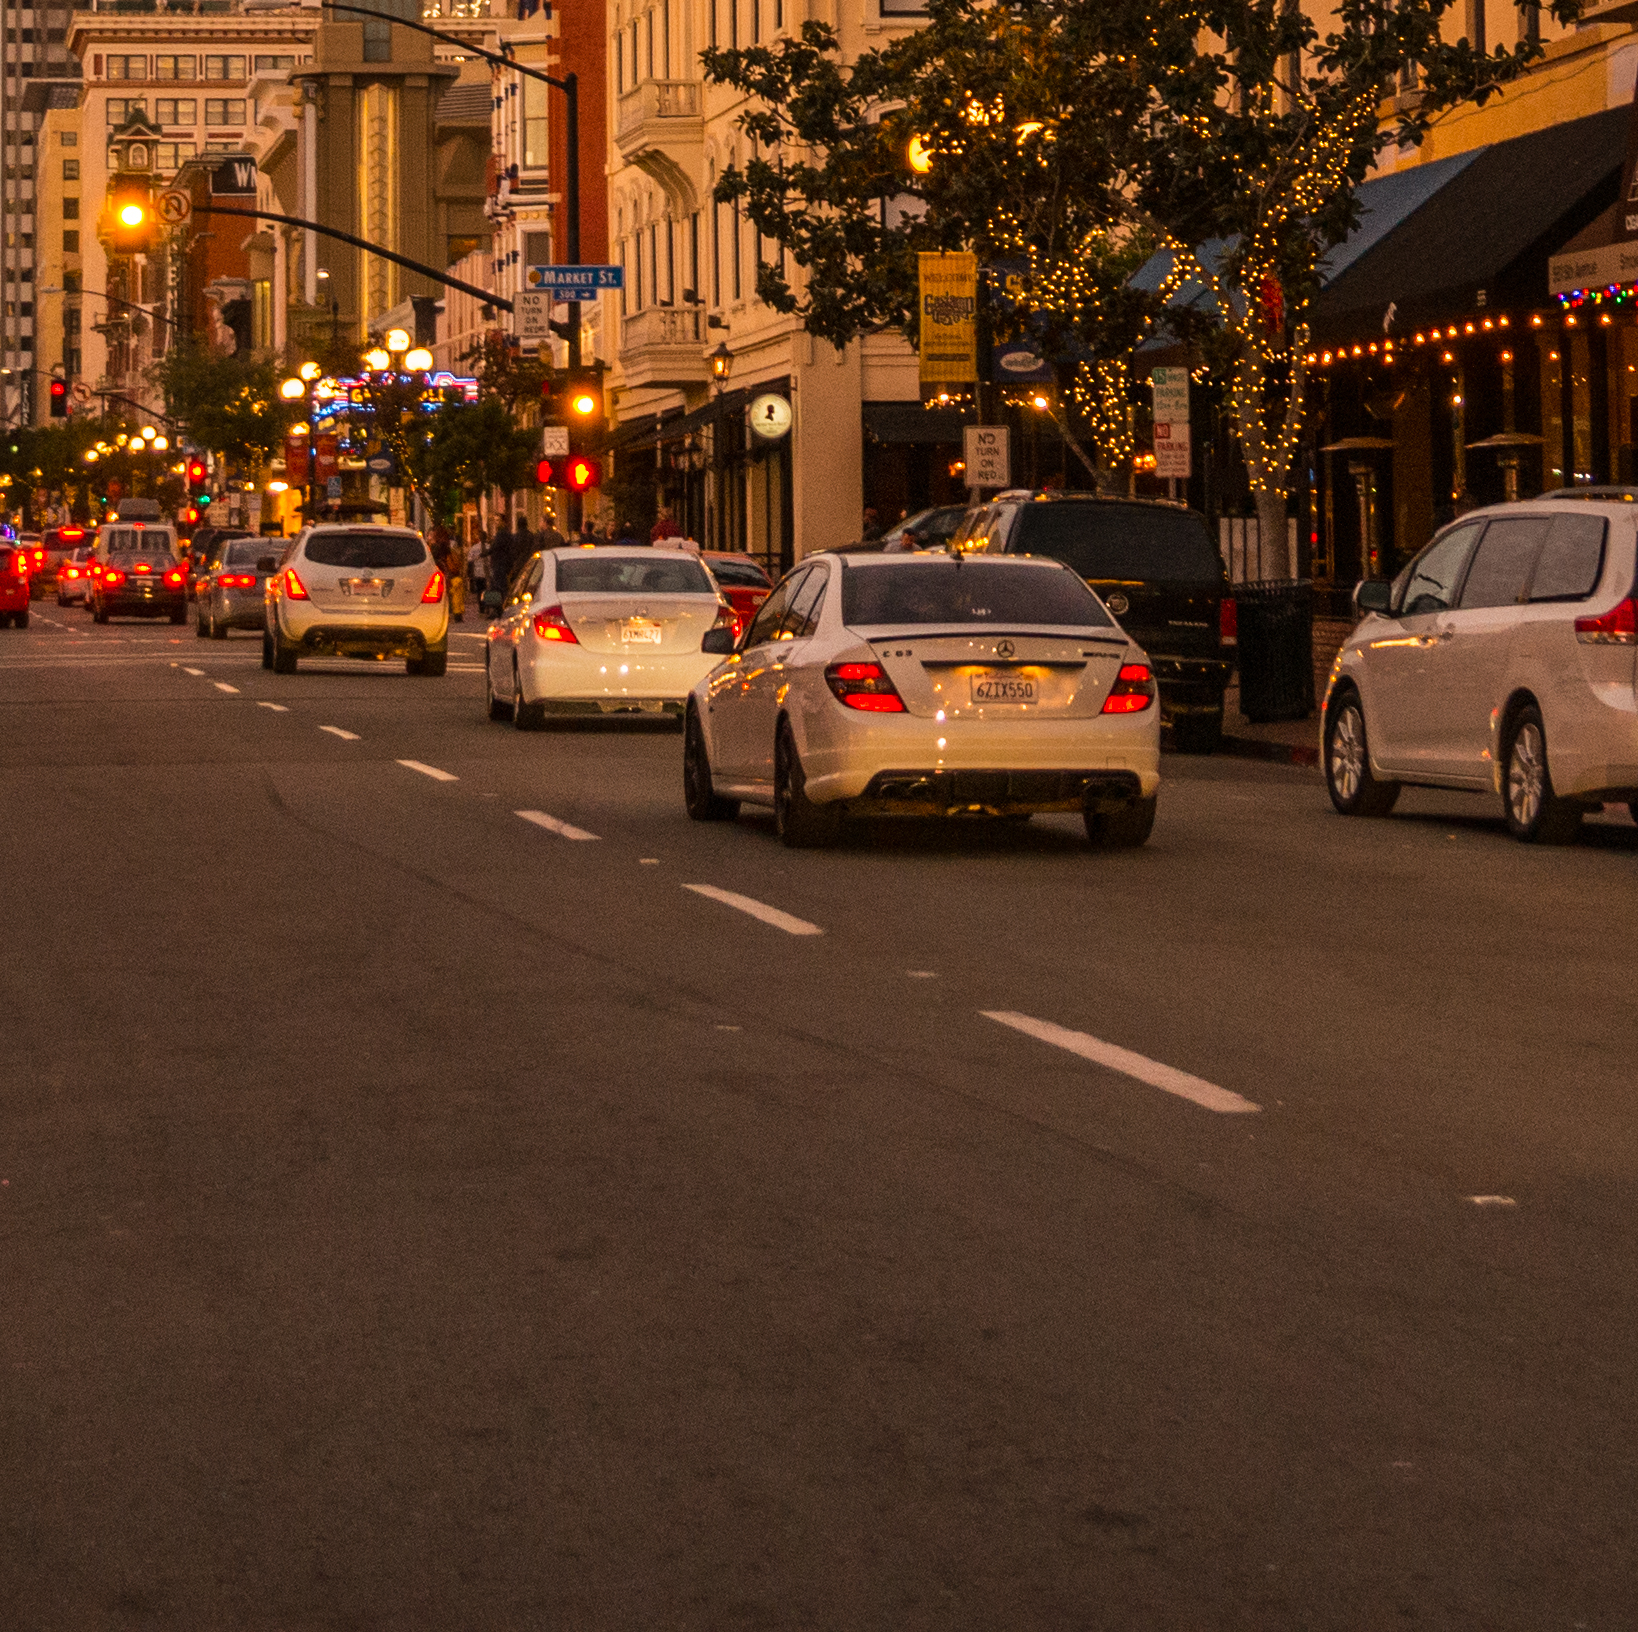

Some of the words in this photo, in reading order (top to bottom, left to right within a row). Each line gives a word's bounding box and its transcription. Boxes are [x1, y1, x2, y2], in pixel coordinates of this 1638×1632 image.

[544, 270, 593, 285] MARKET
[522, 296, 541, 305] NO
[521, 307, 543, 315] TURN
[525, 317, 539, 325] ON
[978, 433, 996, 445] NO
[975, 447, 1000, 456] TURN
[980, 459, 994, 468] ON
[976, 682, 1033, 699] 6ZIX550
